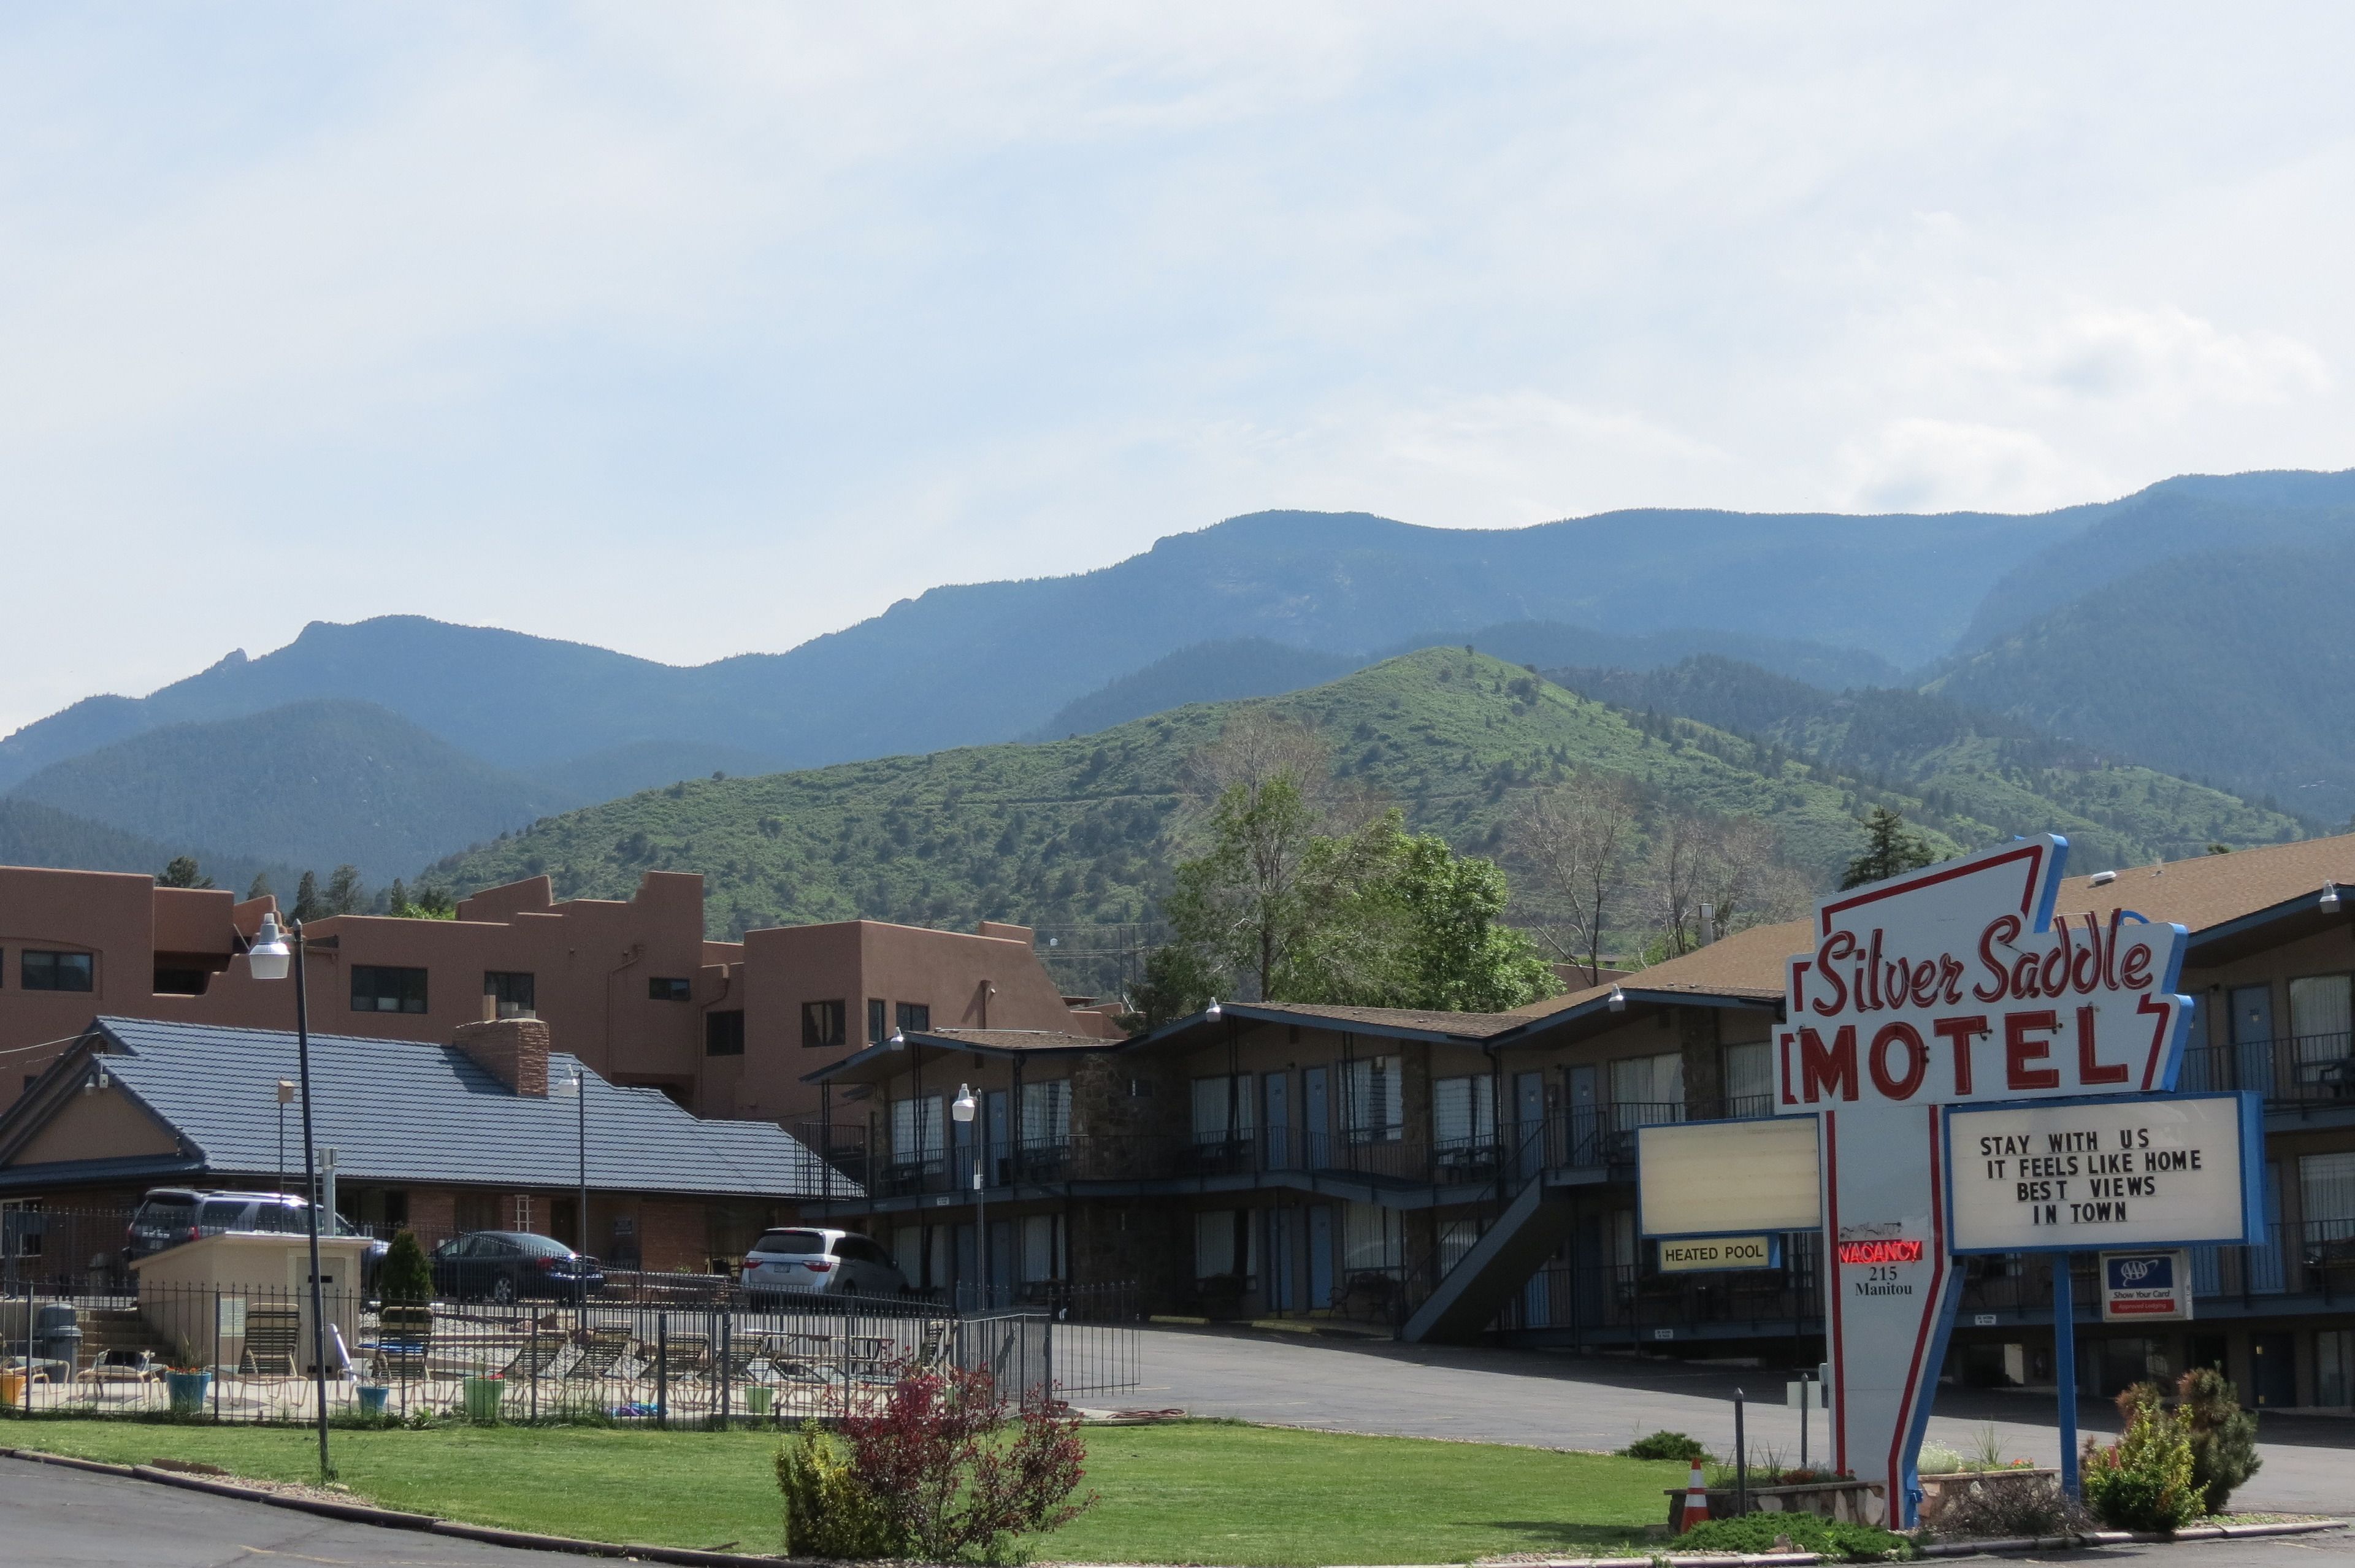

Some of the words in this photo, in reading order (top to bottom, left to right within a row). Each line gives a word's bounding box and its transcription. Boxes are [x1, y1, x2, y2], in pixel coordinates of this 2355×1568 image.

[1812, 928, 1964, 1016] Silver
[1972, 908, 2153, 1003] Saddle
[1800, 1006, 2128, 1104] MOTEL
[1980, 1135, 2030, 1156] STAY
[2048, 1131, 2098, 1153] WITH
[2120, 1128, 2150, 1149] US
[1987, 1160, 2005, 1179] IT
[2020, 1156, 2078, 1177] FEELS
[2088, 1153, 2133, 1174] LIKE
[2145, 1150, 2202, 1171] HOME
[2017, 1180, 2067, 1201] BEST
[2090, 1176, 2155, 1197] VIEWS
[2033, 1205, 2056, 1224] IN
[2070, 1202, 2126, 1223] TOWN
[1666, 1247, 1718, 1261] HEATED
[1725, 1245, 1763, 1258] POOL
[1839, 1241, 1920, 1263] VACANCY
[1869, 1266, 1897, 1281] 215
[2123, 1261, 2145, 1279] AAA
[1856, 1282, 1912, 1296] Manitou
